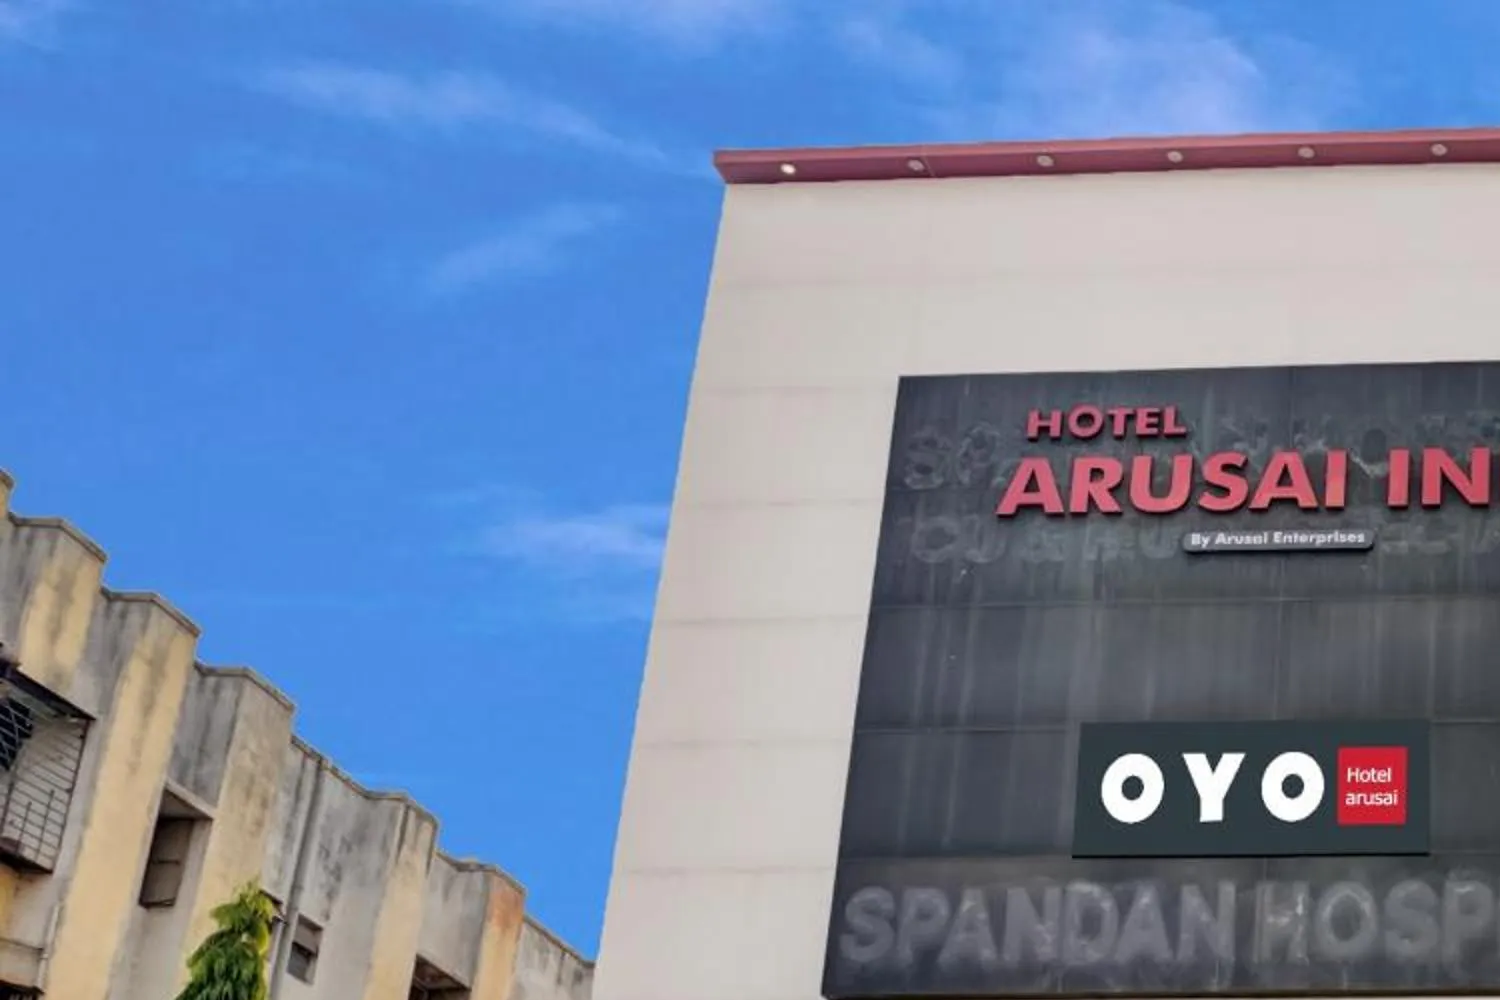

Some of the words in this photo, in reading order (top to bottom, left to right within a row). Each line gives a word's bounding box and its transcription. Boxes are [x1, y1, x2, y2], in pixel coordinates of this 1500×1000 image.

[1024, 404, 1188, 441] HOTEL
[995, 447, 1349, 517] ARUSAI
[1191, 532, 1210, 548] By
[1215, 531, 1268, 546] Arusai
[1273, 530, 1366, 548] Enterprises
[1101, 751, 1325, 824] OYO
[1347, 767, 1392, 783] Hotel
[1345, 789, 1399, 806] arusai
[840, 880, 1237, 964] SPANDAN
